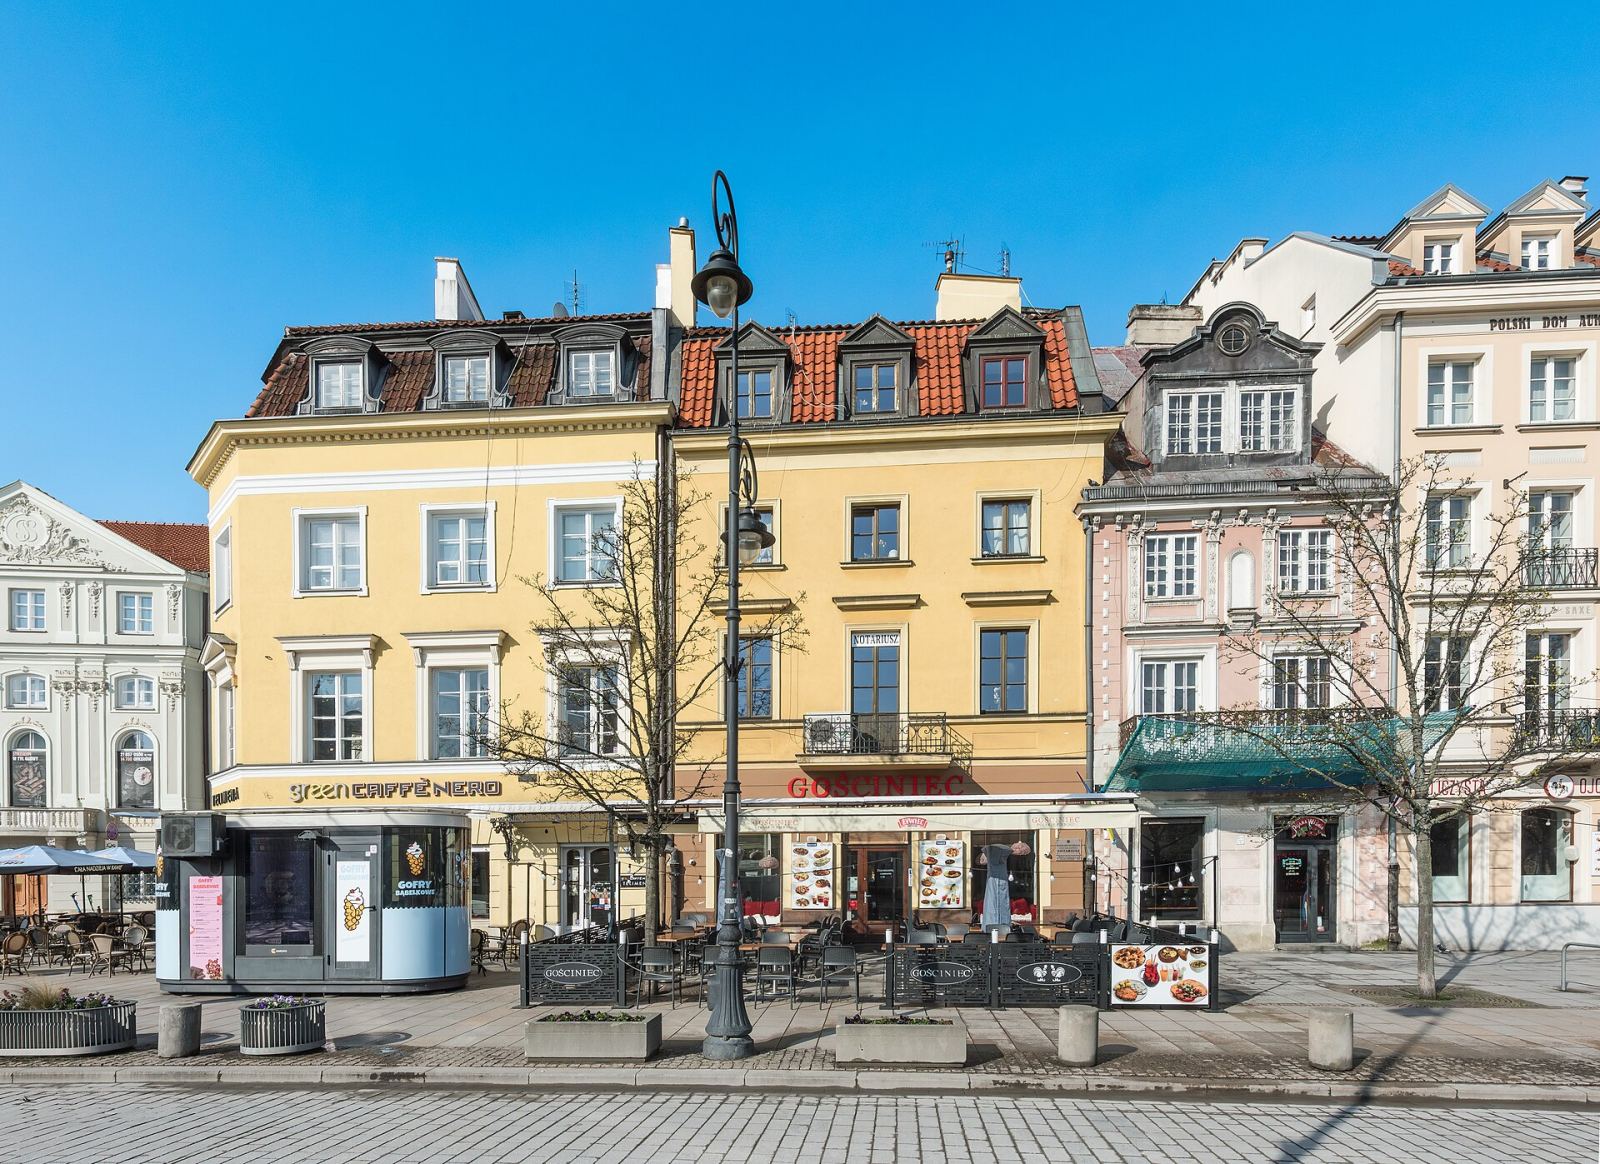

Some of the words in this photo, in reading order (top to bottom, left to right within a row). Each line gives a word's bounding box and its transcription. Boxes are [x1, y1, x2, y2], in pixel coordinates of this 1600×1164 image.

[1490, 317, 1531, 331] POLSKI
[1542, 315, 1568, 329] DOM
[853, 634, 899, 645] NOTARIUSZ
[787, 773, 964, 798] GOŚCINIEC
[289, 782, 350, 803] green
[433, 780, 503, 798] NERO
[397, 880, 433, 889] GOFRY
[545, 968, 600, 977] GOŚCINIEC
[912, 968, 971, 978] GOŚCINIEC
